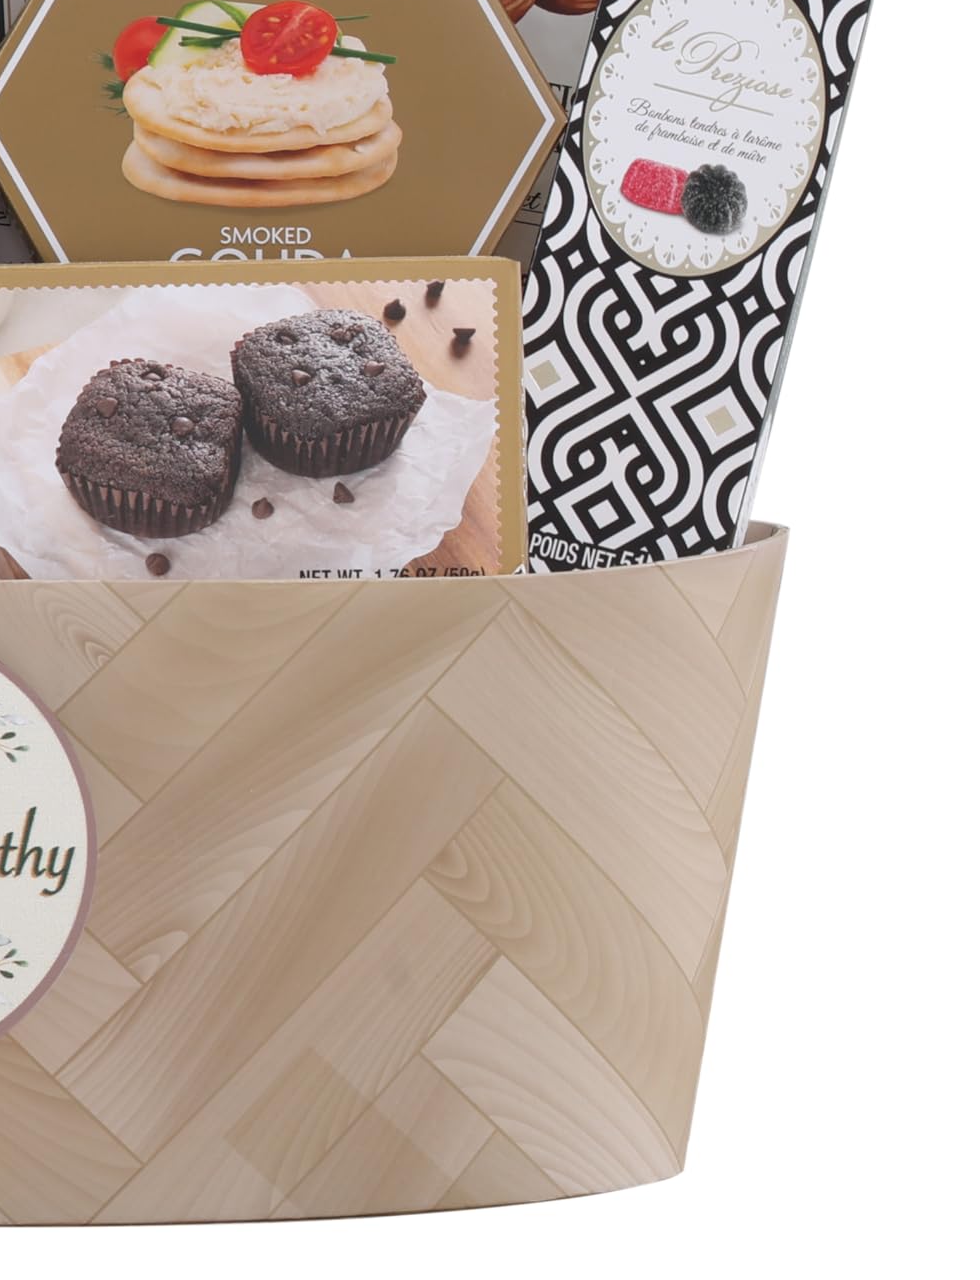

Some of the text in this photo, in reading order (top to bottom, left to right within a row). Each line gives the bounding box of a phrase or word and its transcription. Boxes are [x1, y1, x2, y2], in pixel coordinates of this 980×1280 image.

[651, 19, 794, 112] le Preziose
[626, 97, 685, 127] Bonbons
[634, 120, 649, 132] de
[648, 123, 705, 147] framboise
[707, 139, 721, 151] et
[721, 143, 734, 155] de
[220, 226, 311, 245] SMOKED
[529, 533, 579, 564] POIDS
[581, 546, 616, 569] NET
